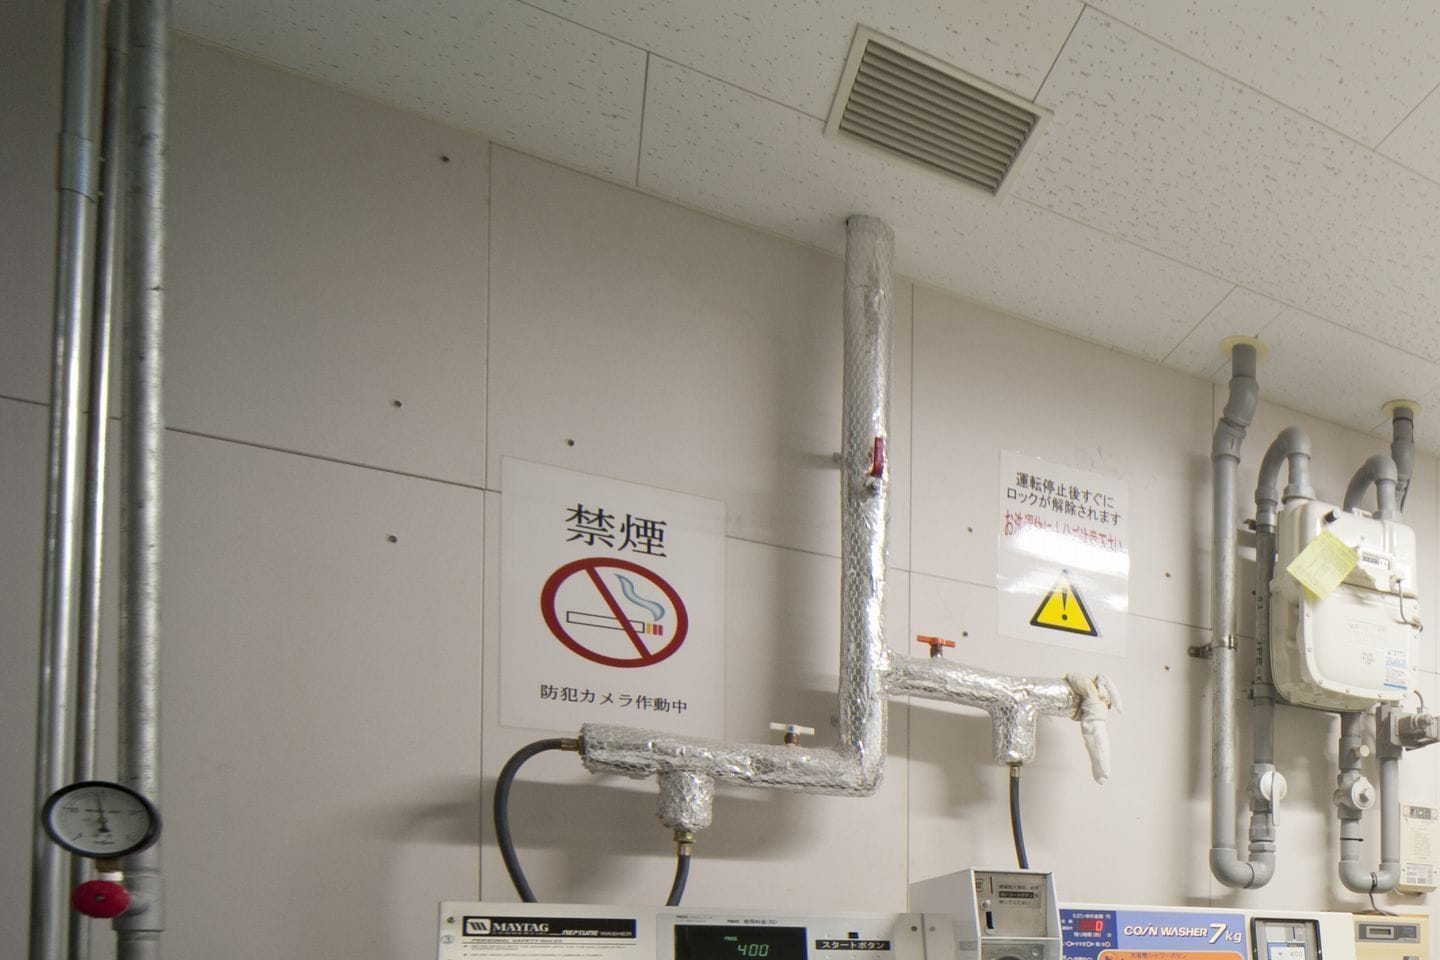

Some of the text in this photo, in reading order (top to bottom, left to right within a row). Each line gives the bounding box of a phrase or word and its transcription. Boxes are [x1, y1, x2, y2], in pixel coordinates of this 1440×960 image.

[1016, 472, 1114, 508] 運転停止後すぐに
[1007, 488, 1122, 526] ロックが解除されます
[565, 503, 667, 558] 禁煙
[540, 684, 688, 714] 防犯カメラ作動中
[492, 922, 549, 933] MAYTAG
[1124, 922, 1158, 936] COIN
[1161, 927, 1208, 937] WASHER
[737, 944, 769, 957] 400
[822, 941, 885, 950] スタートボタン
